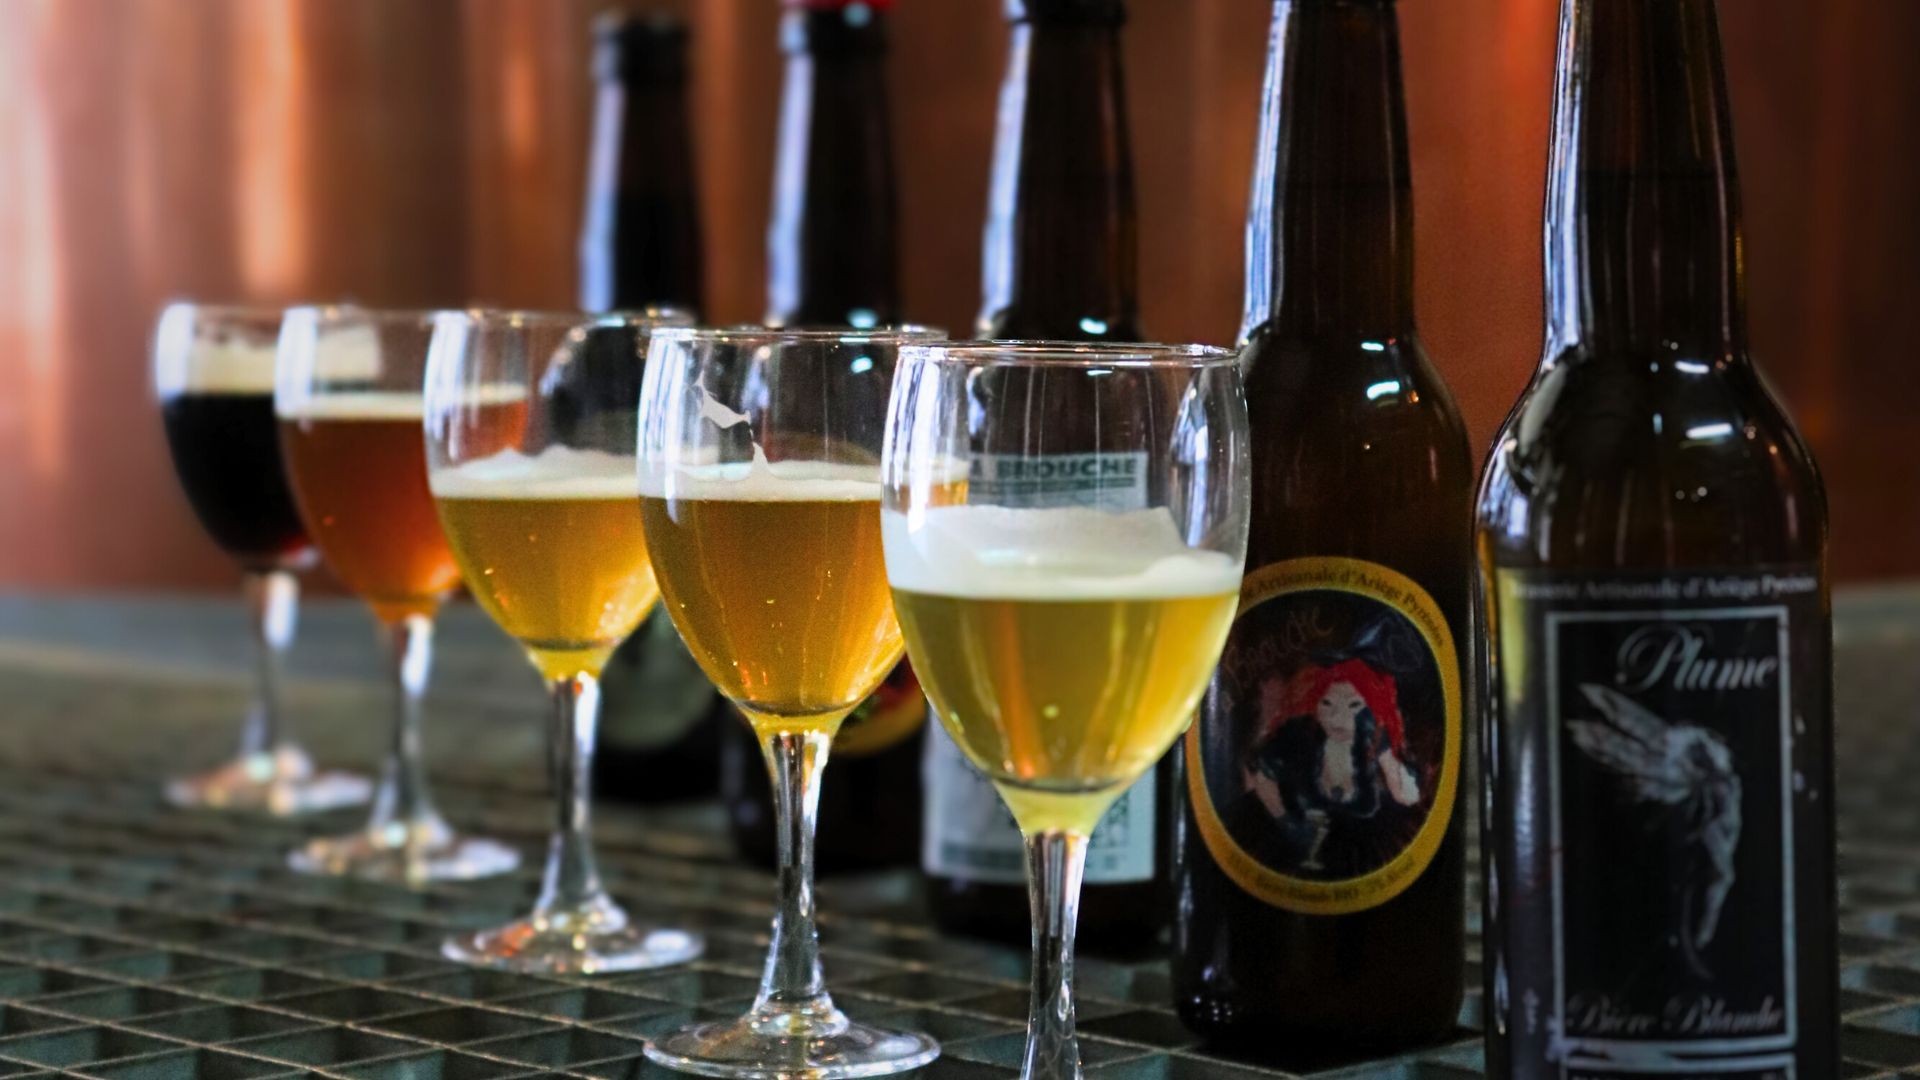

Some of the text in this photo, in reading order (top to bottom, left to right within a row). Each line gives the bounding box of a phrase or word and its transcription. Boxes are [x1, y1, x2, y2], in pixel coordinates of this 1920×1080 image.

[996, 457, 1137, 478] BROUCHE
[1257, 566, 1334, 591] Artisanale
[1614, 622, 1779, 692] Plume
[1661, 993, 1784, 1034] Blanche
